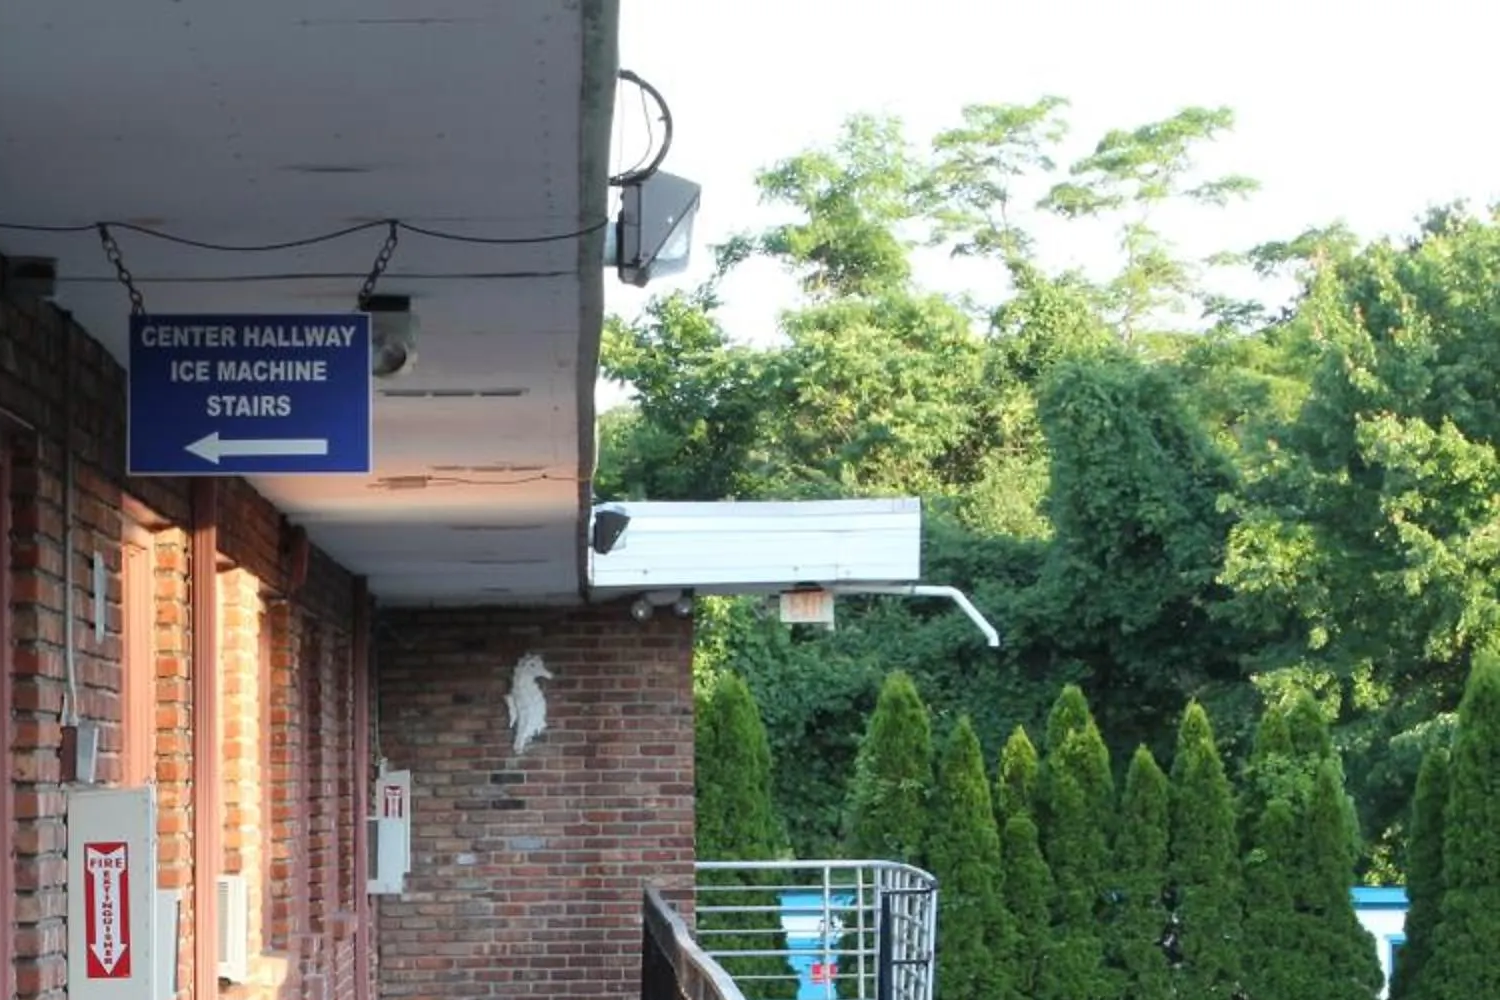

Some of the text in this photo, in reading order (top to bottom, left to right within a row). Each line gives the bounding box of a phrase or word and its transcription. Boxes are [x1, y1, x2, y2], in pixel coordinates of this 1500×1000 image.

[141, 325, 356, 347] CENTER HALLWAY
[170, 360, 327, 382] ICE MACHINE
[206, 395, 291, 417] STAIRS
[89, 857, 123, 869] FIRE
[102, 870, 113, 964] EXTINGUISHER
